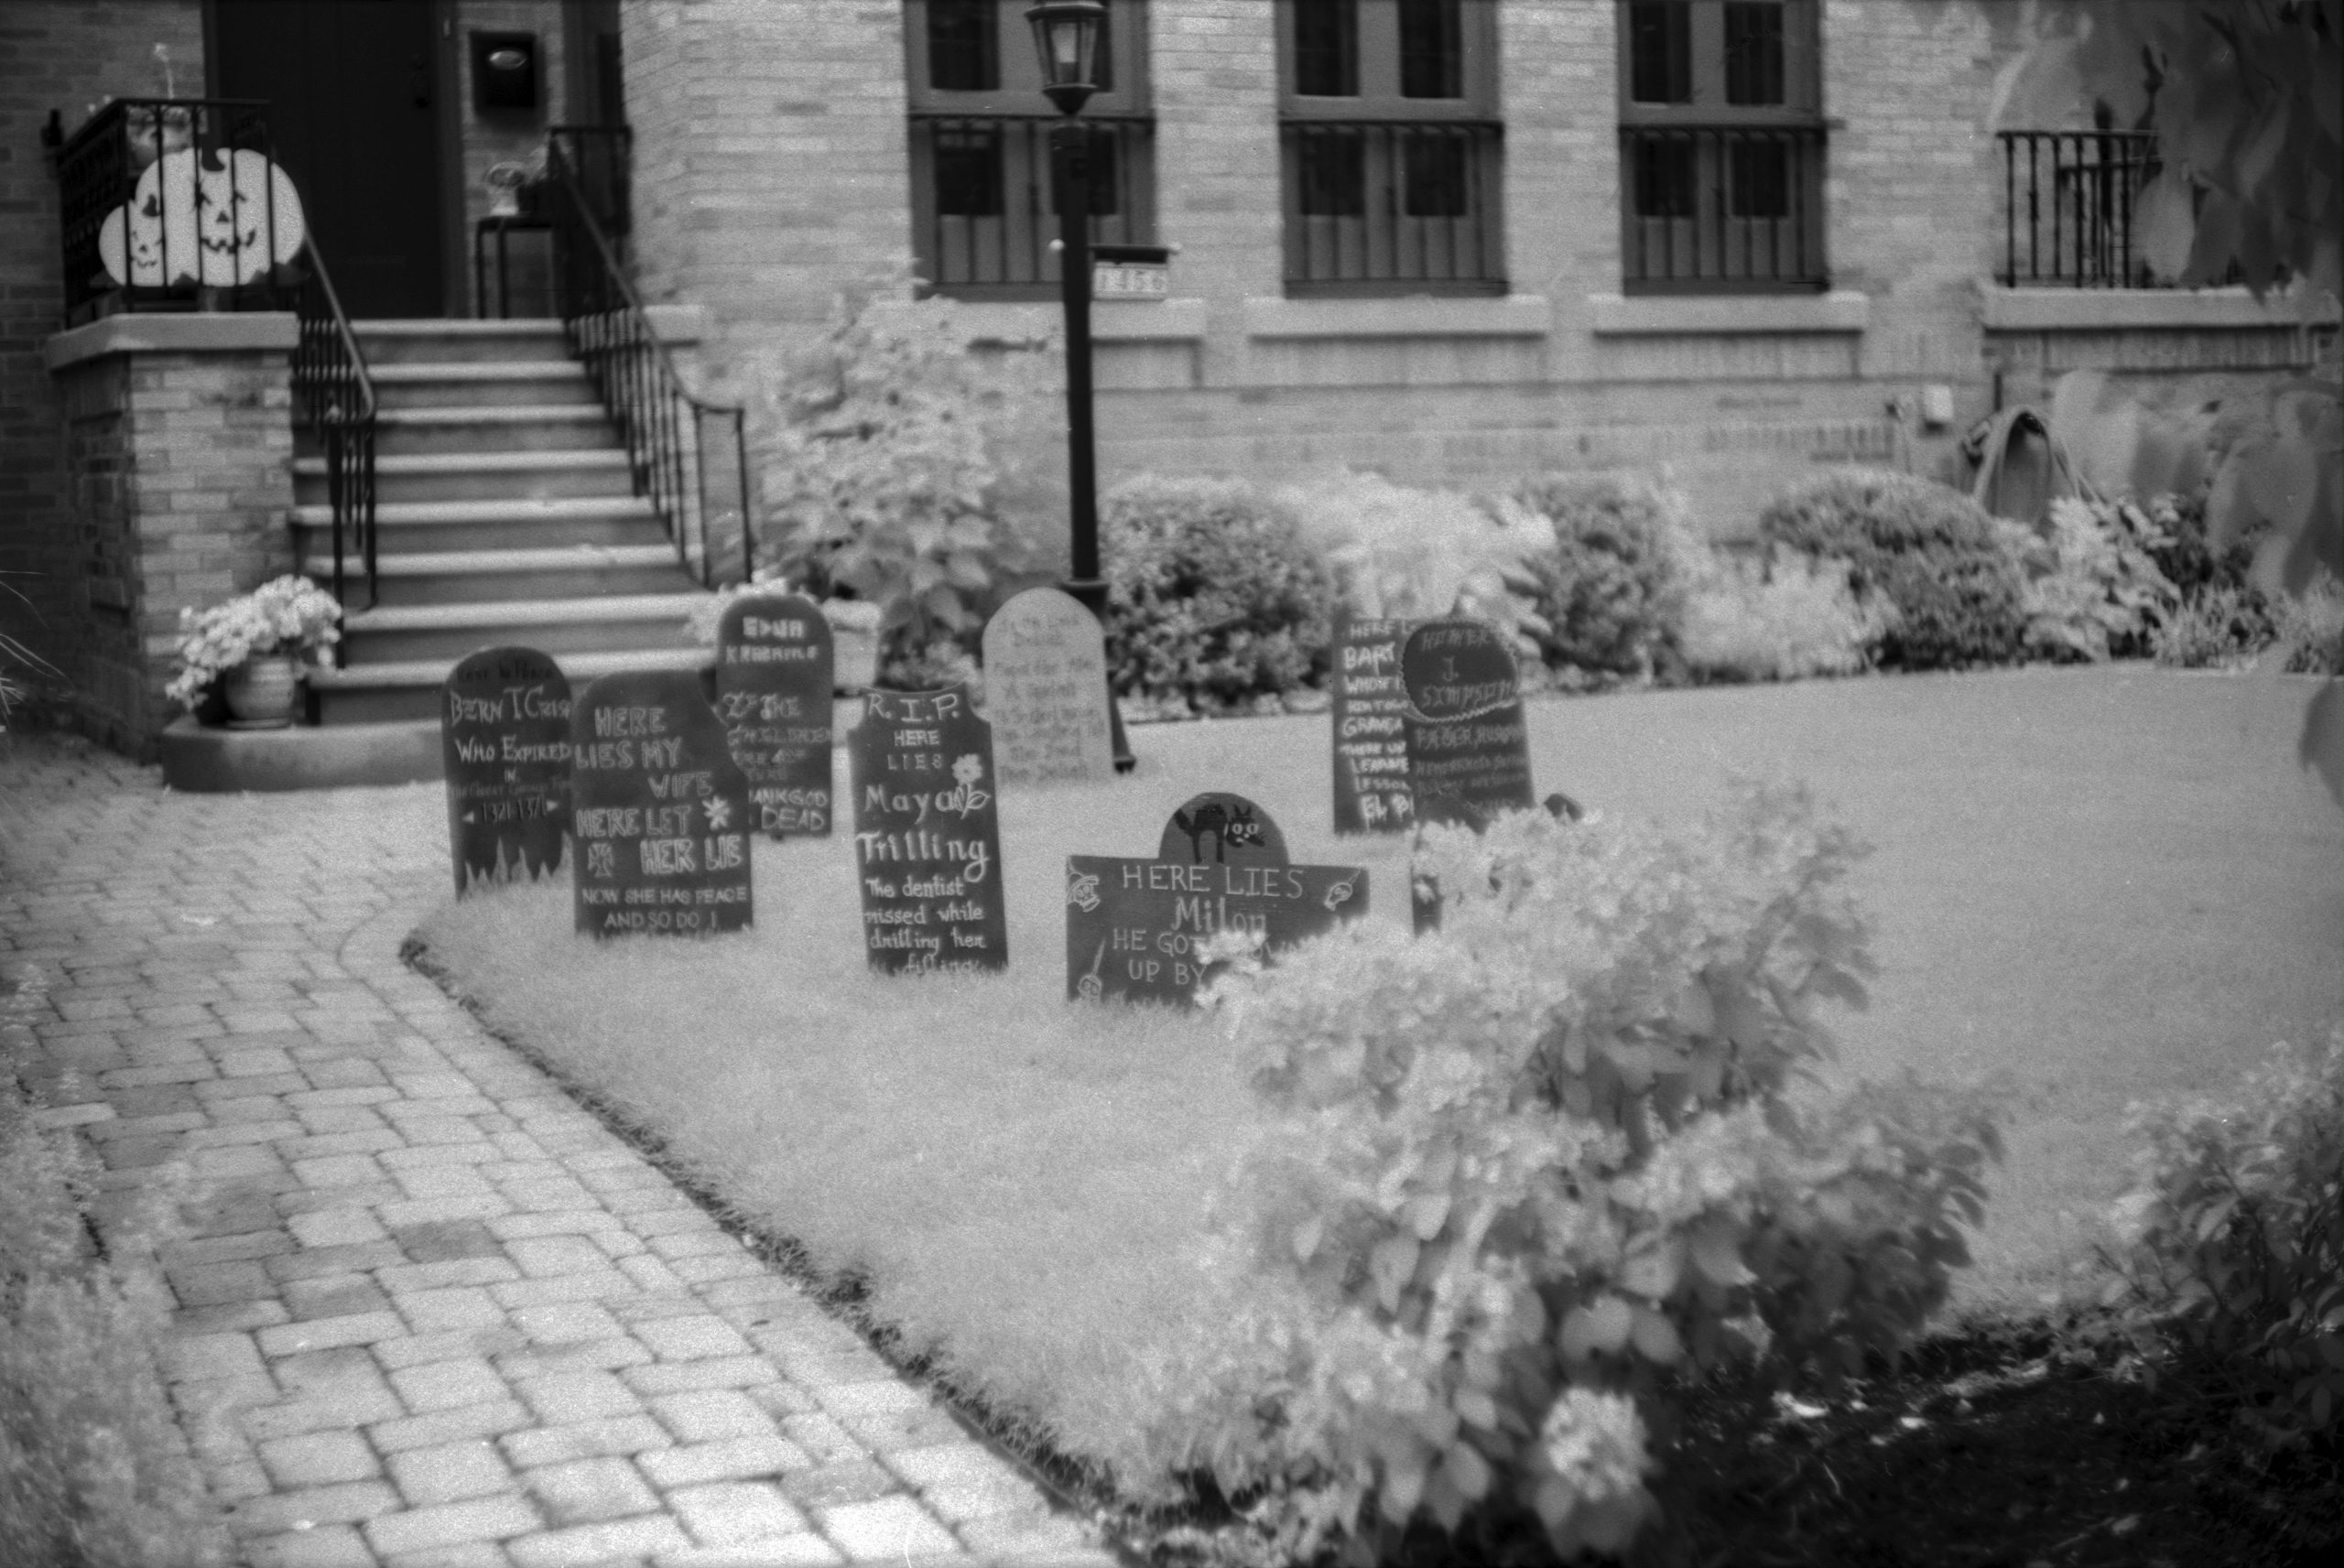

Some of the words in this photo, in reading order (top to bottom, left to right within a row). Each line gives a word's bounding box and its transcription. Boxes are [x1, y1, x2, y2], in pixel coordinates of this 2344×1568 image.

[743, 616, 804, 639] EDNA
[1343, 642, 1395, 676] BART
[503, 685, 525, 720] T
[595, 707, 666, 737] HERE
[895, 730, 940, 746] HERE
[574, 740, 635, 769] LIES
[641, 736, 683, 768] MY
[888, 752, 943, 770] LIES
[648, 771, 712, 798] WIFE
[788, 789, 828, 806] GOD
[762, 805, 825, 830] DEAD
[864, 784, 955, 824] Maya
[576, 807, 640, 838] HERE
[646, 805, 692, 836] LET
[640, 838, 696, 874] HER
[704, 834, 743, 871] LIE
[856, 829, 990, 882] Trilling
[582, 888, 619, 903] NOW
[624, 888, 656, 903] SHE
[660, 888, 690, 903] HAS
[696, 886, 748, 903] PEACE
[865, 877, 895, 897] The
[902, 874, 964, 897] dentist
[1123, 865, 1210, 892] HERE
[1225, 866, 1304, 899] LIES
[604, 911, 645, 928] AND
[646, 911, 671, 927] SO
[676, 911, 700, 927] DO
[711, 911, 717, 927] I
[863, 903, 928, 925] missed
[937, 901, 985, 922] while
[870, 927, 940, 957] drilling
[950, 926, 986, 948] her
[1112, 928, 1147, 951] HE
[1128, 959, 1160, 982] UP
[1175, 963, 1207, 986] BY
